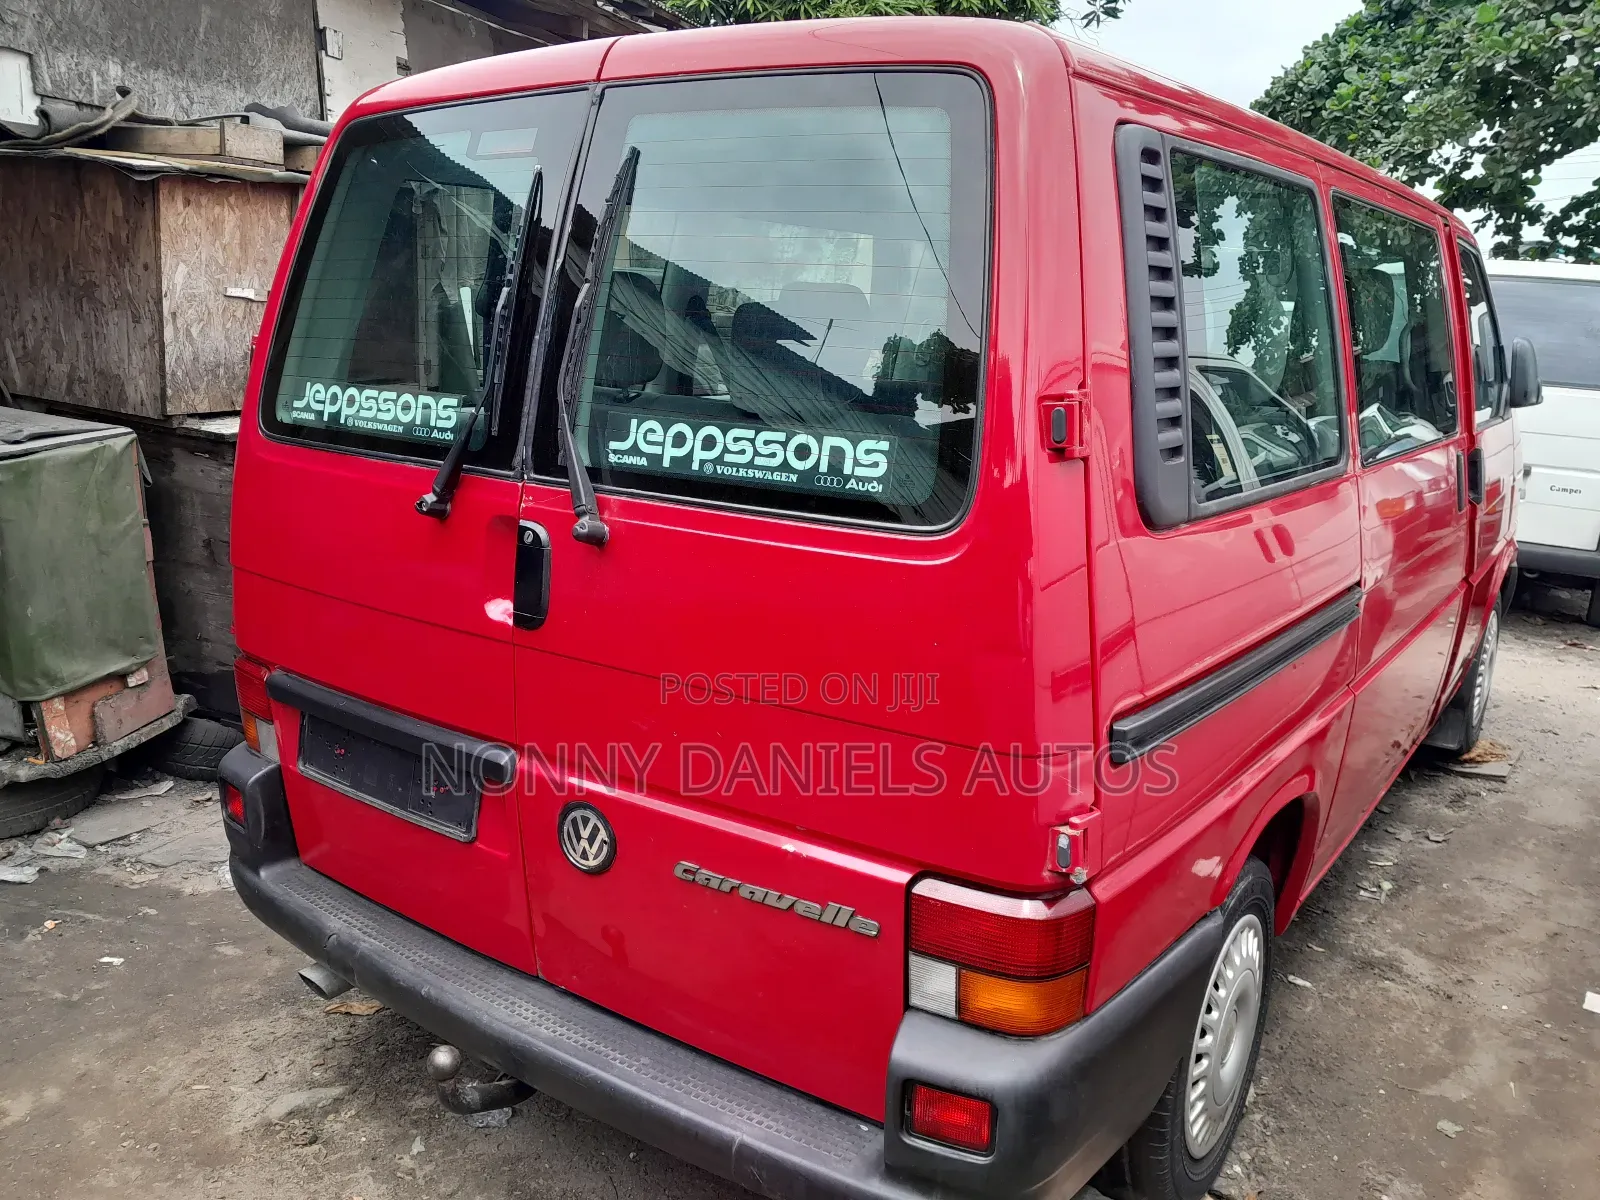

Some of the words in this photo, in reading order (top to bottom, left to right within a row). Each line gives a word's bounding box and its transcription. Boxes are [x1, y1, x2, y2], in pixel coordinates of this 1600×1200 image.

[292, 410, 315, 421] SCANIA
[354, 419, 404, 433] VOLKSWAGEN
[431, 429, 454, 441] Audi
[608, 453, 648, 467] SCANIA
[716, 464, 798, 483] VOLKSWAGEN
[845, 478, 883, 493] Audi
